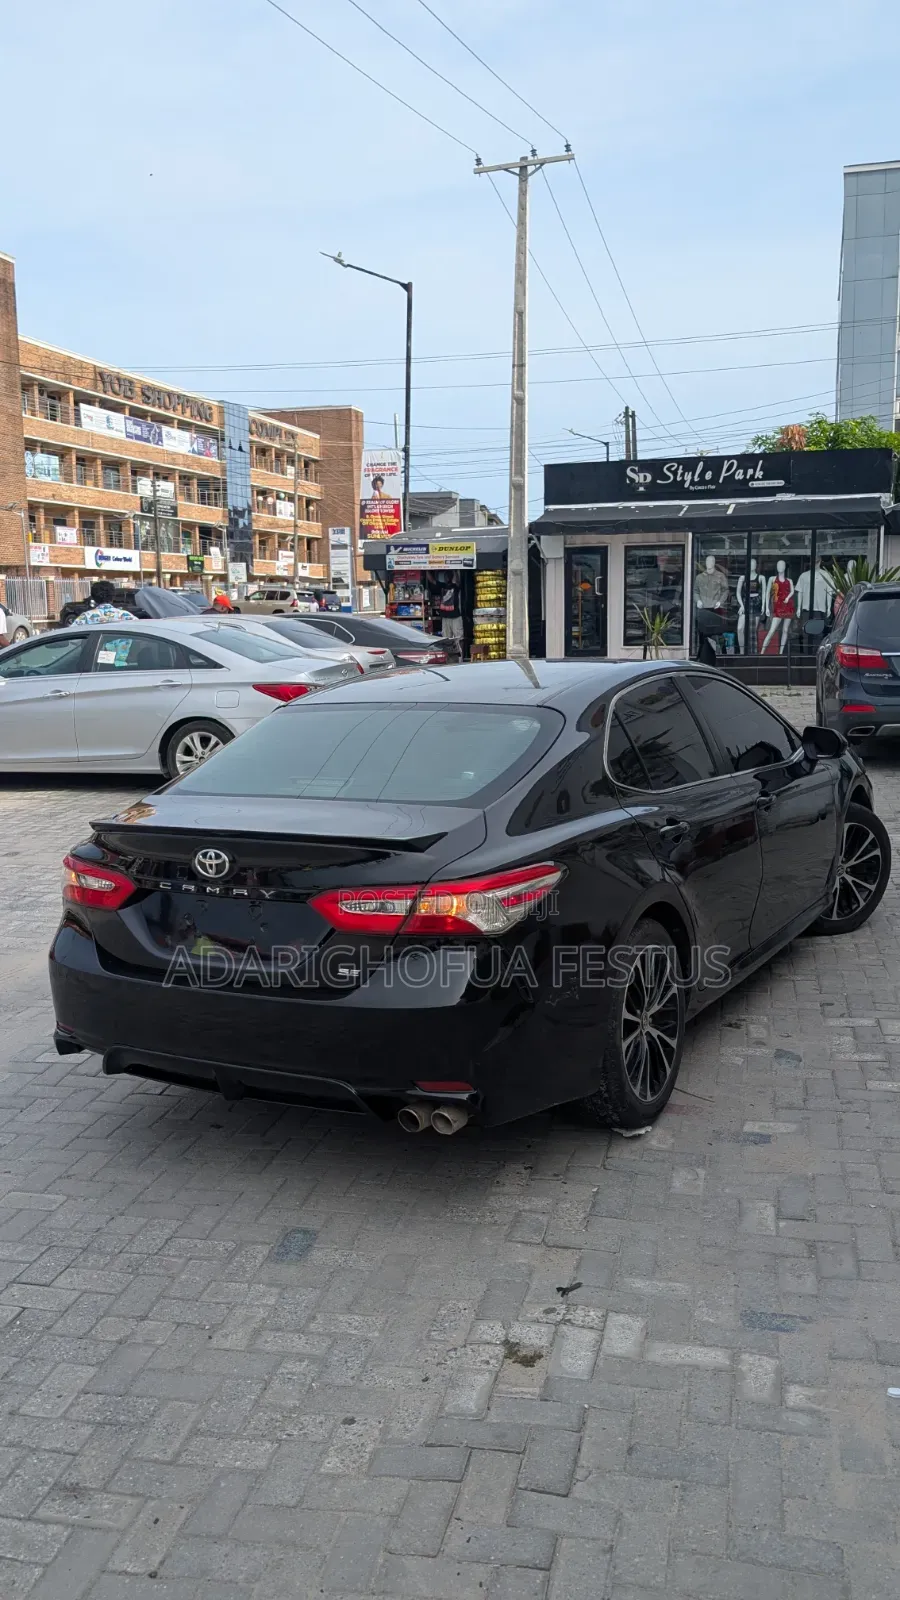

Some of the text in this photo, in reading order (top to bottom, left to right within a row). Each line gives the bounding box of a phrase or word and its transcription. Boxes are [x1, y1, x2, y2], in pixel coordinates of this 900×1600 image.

[141, 384, 213, 422] SHOPPING
[656, 461, 713, 488] Style
[718, 459, 764, 484] Park
[159, 881, 276, 899] CAMRY
